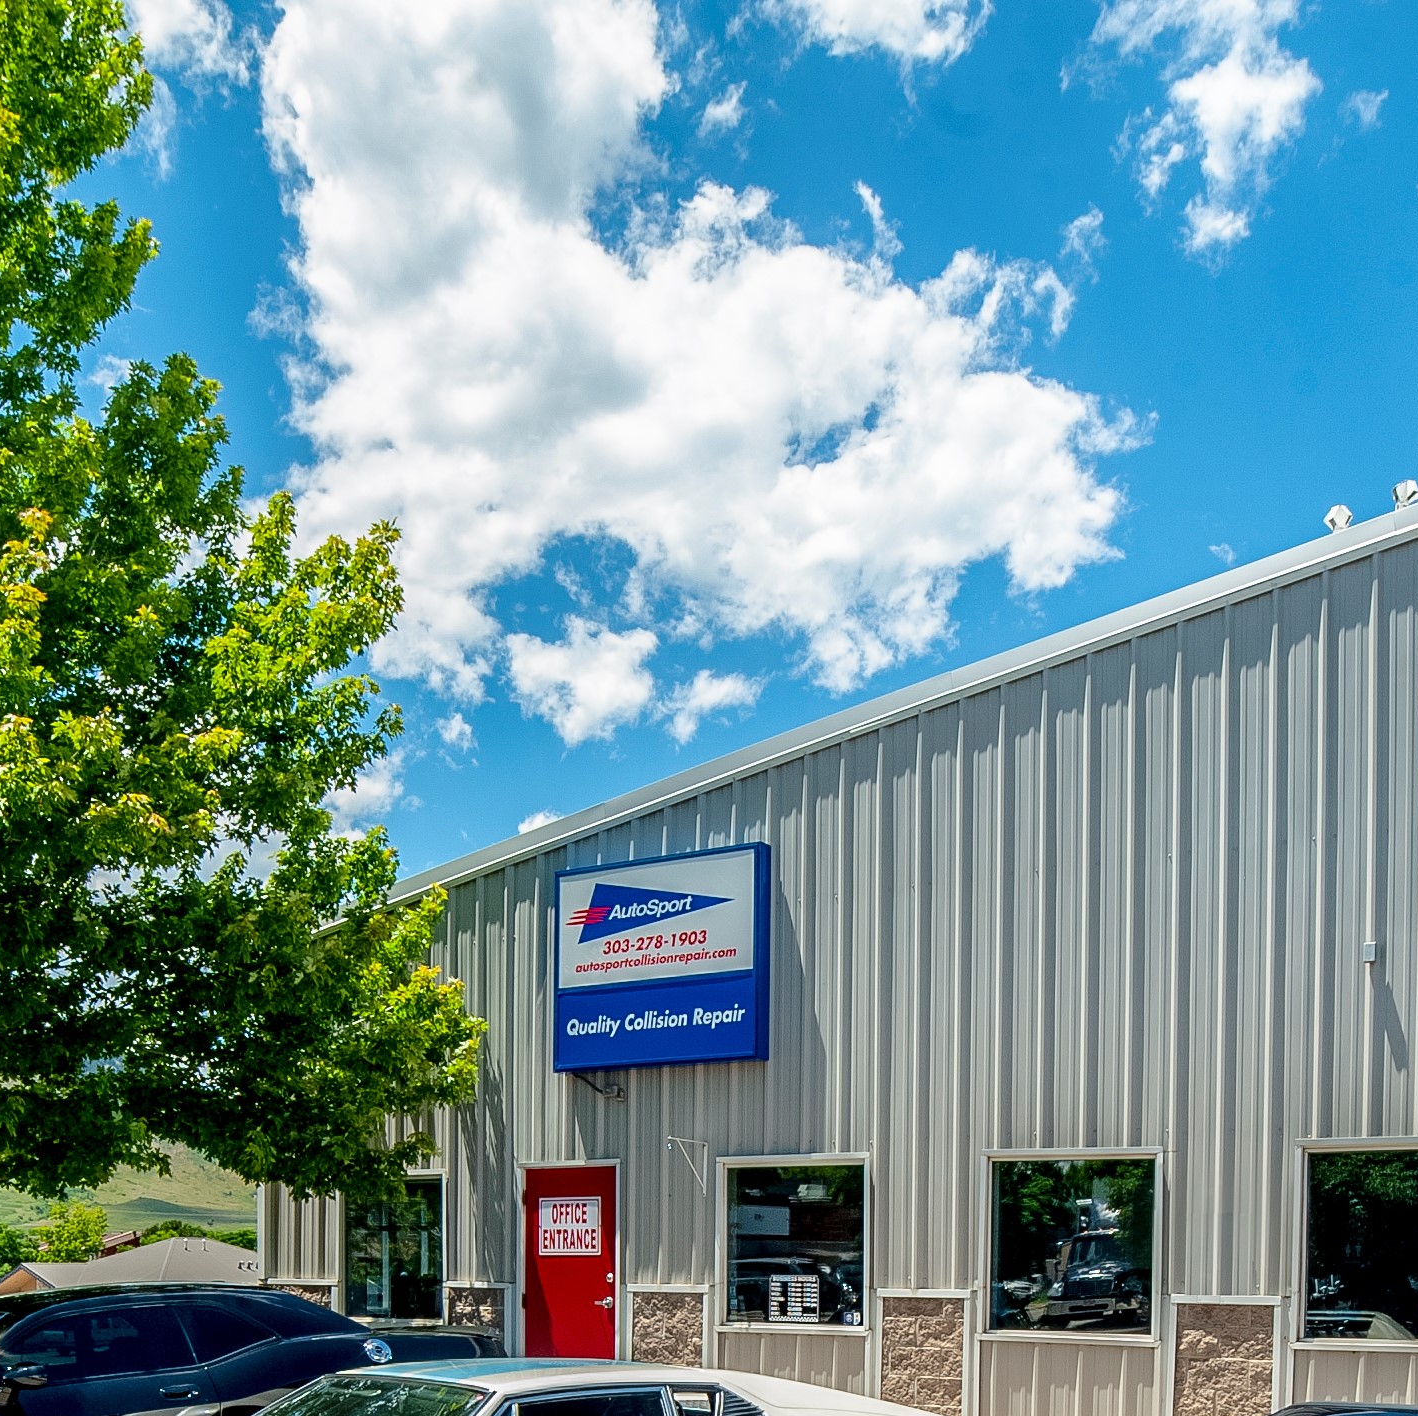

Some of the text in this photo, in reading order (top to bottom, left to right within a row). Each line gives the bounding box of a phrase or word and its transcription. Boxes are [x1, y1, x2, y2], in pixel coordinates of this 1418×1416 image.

[608, 895, 693, 921] AutoSport
[603, 930, 707, 955] 303-278-1903
[575, 947, 737, 973] autosportcollisionrepair.com
[566, 1003, 746, 1038] Quality Collision Repair
[551, 1203, 588, 1225] OFFICE
[543, 1228, 597, 1250] ENTRANCE
